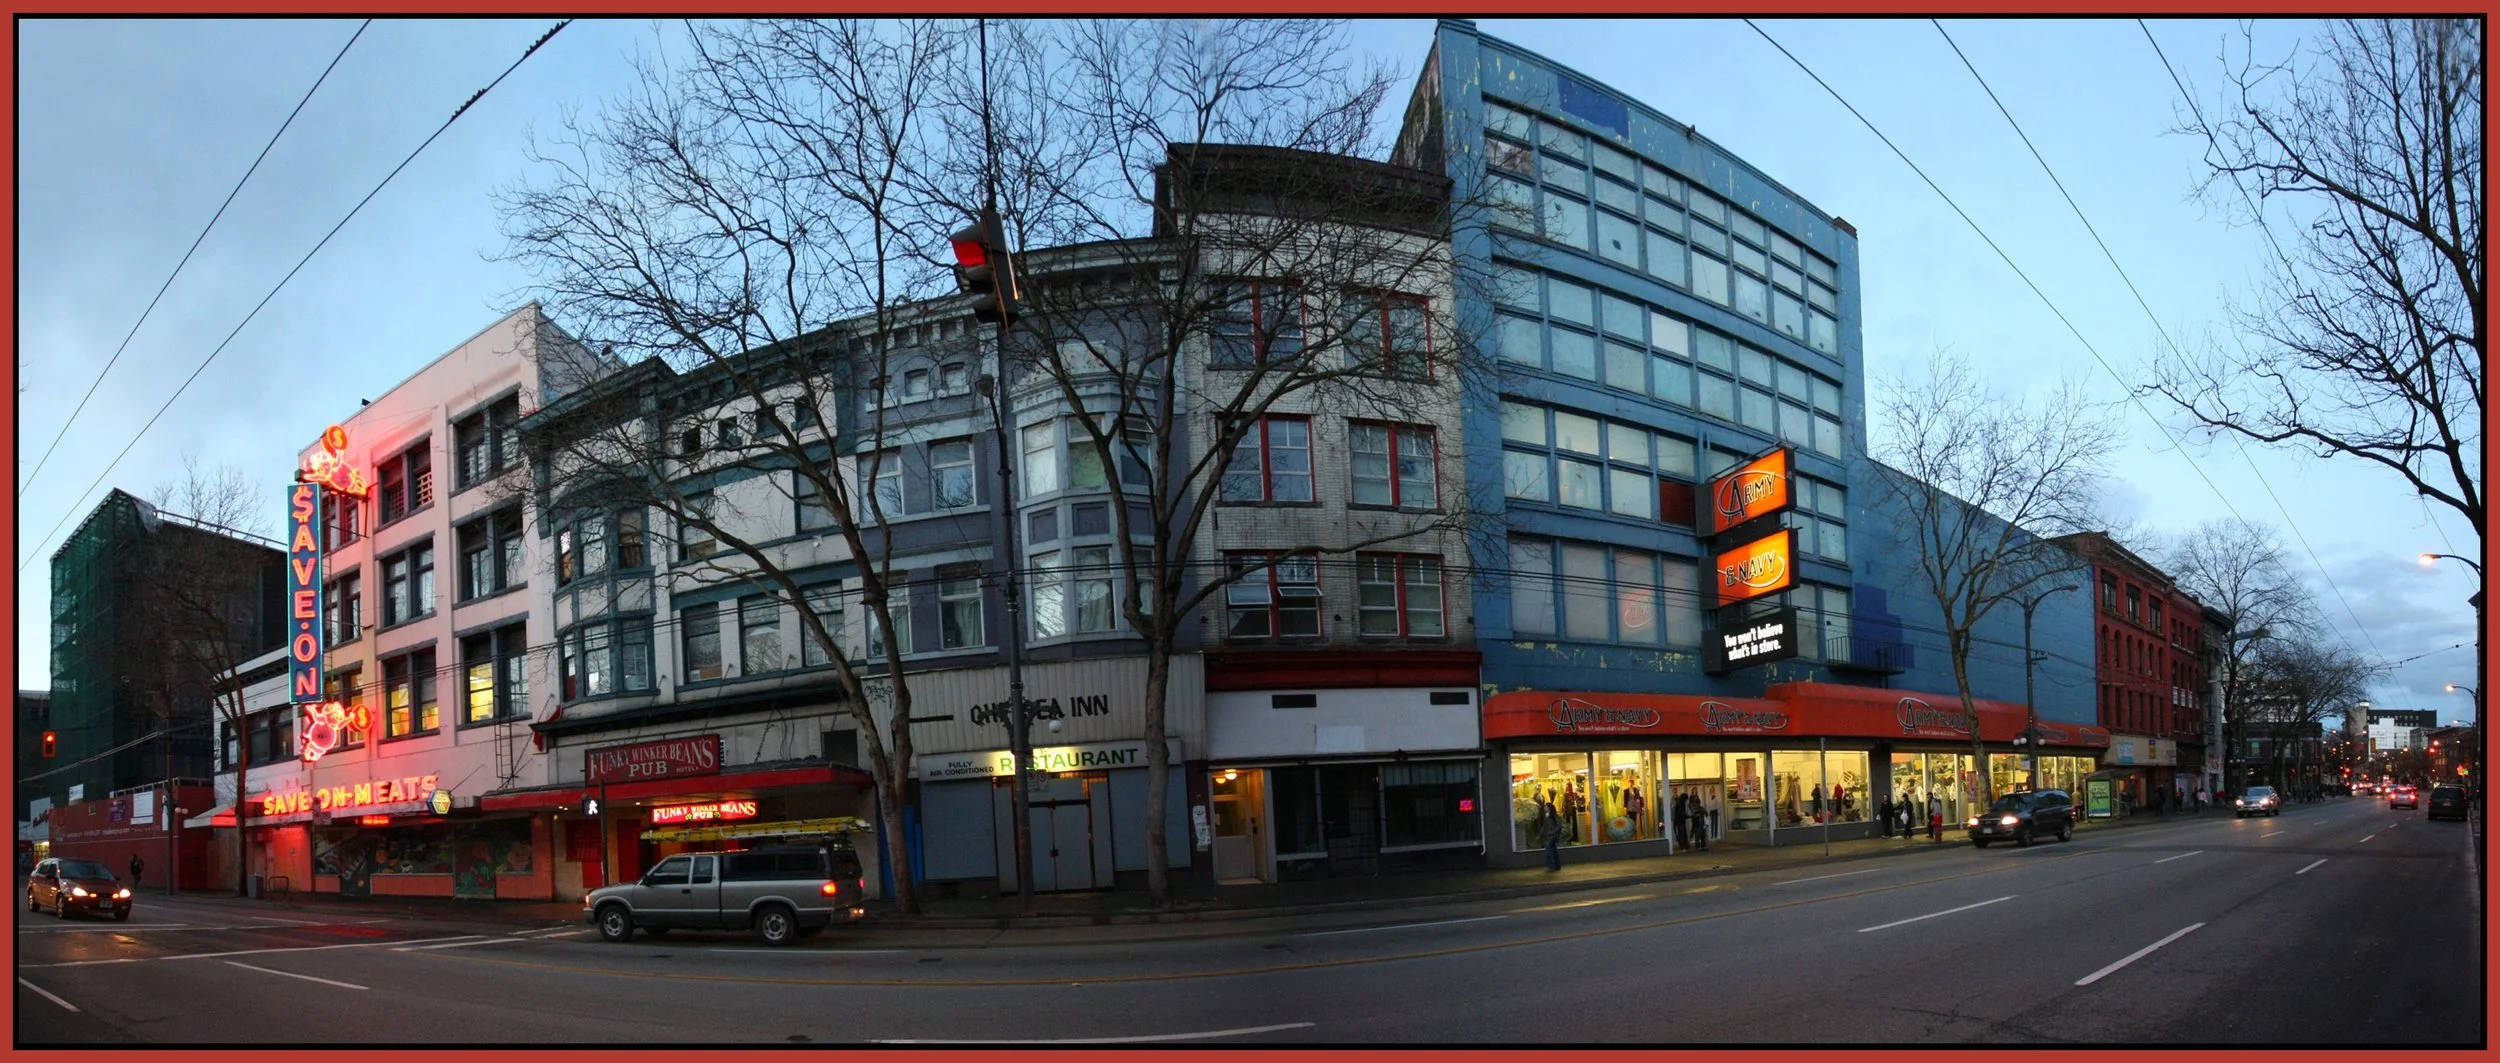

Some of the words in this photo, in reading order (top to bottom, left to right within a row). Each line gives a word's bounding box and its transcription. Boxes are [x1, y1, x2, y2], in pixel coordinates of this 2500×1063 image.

[1727, 471, 1776, 525] ARMY
[1725, 565, 1735, 587] &
[1737, 550, 1777, 584] NAVY
[1724, 634, 1737, 648] You
[1737, 627, 1757, 645] won't
[1757, 623, 1783, 640] believe
[1728, 644, 1750, 661] what's
[1750, 642, 1759, 655] in
[1759, 639, 1781, 654] store.
[1070, 694, 1109, 718] INN
[1557, 700, 1603, 733] ARMY
[1616, 708, 1652, 724] NAVY
[590, 750, 629, 780] FUNKY
[631, 744, 668, 762] WINKER
[629, 760, 668, 777] PUB
[930, 769, 942, 777] AIR
[945, 766, 995, 776] CONDITIONED
[1000, 748, 1138, 773] RSTAURANT
[653, 806, 688, 822] FUNKY
[691, 804, 718, 812] WINKER
[692, 811, 714, 820] PUB
